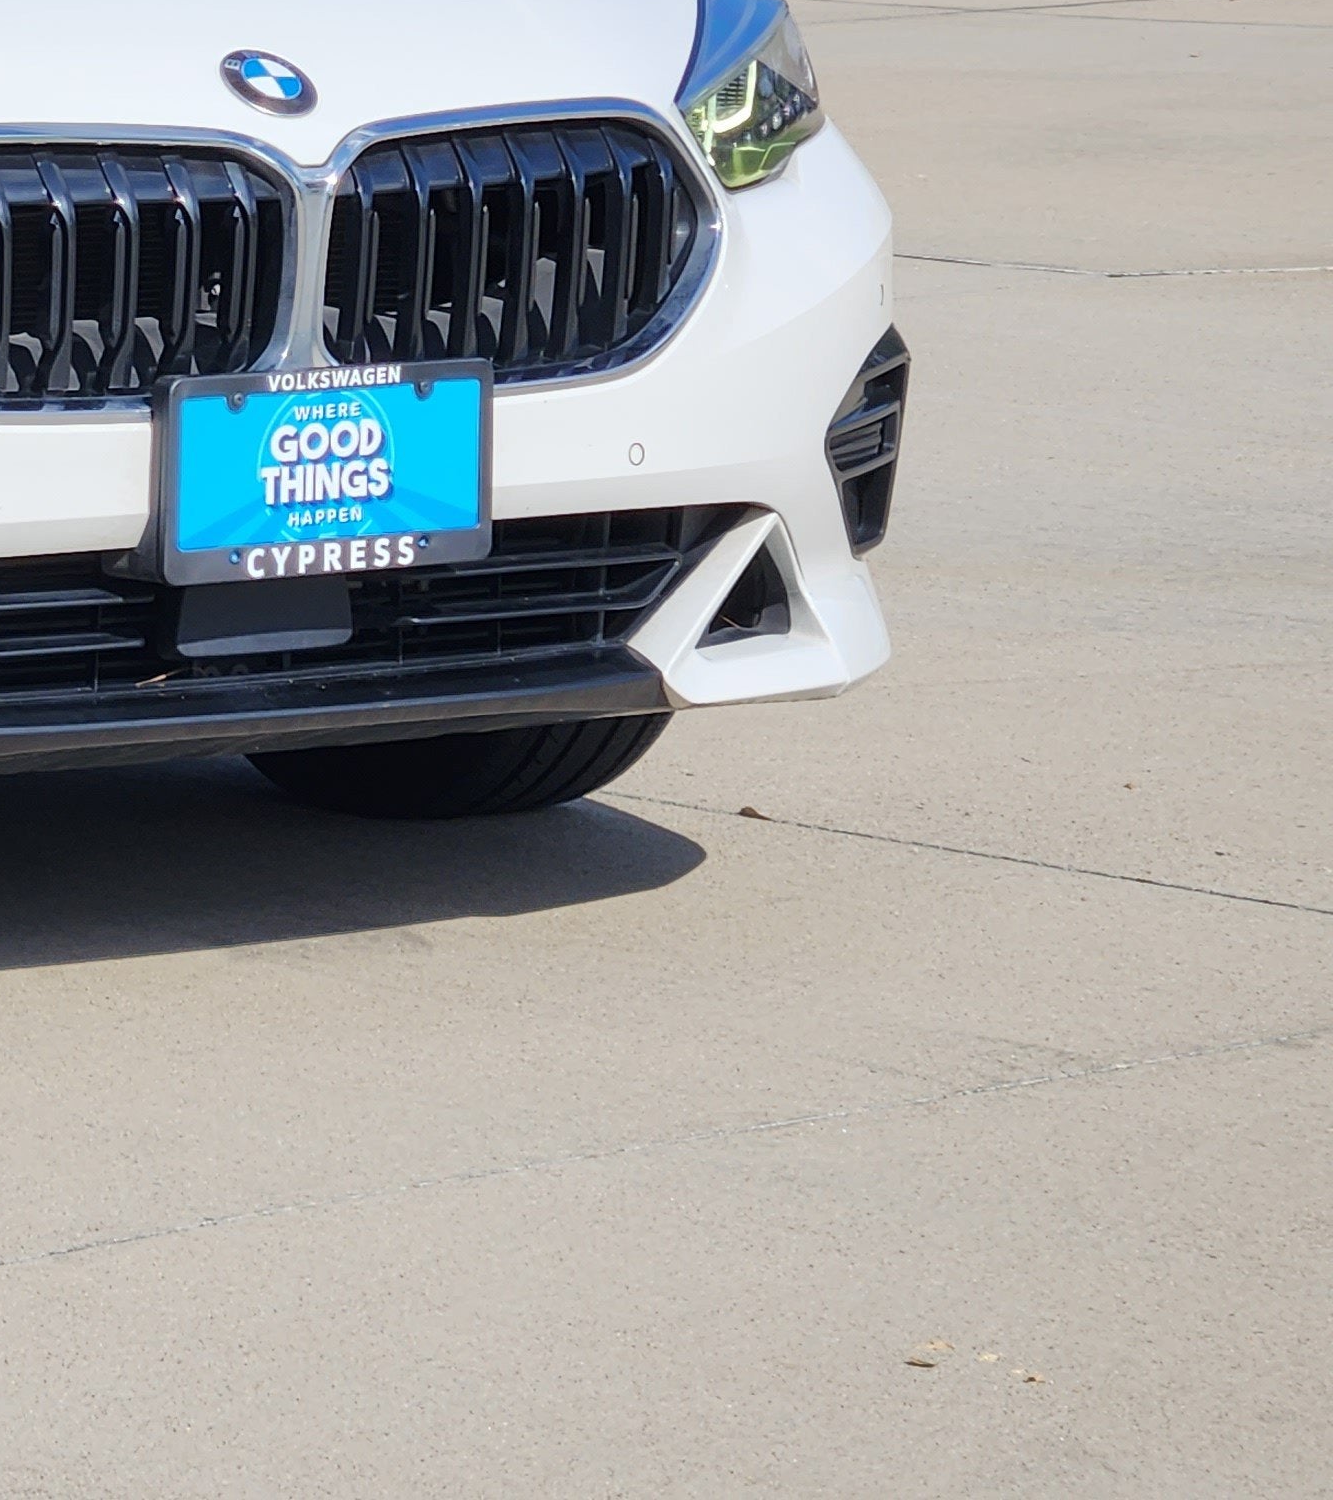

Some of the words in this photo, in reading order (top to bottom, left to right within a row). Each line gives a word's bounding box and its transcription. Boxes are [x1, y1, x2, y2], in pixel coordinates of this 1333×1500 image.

[267, 365, 402, 392] VOLKSWAGEN
[293, 402, 362, 420] WHERE
[269, 418, 384, 463] GOOD
[260, 461, 392, 506] THINGS
[287, 506, 364, 528] HAPPEN
[246, 535, 416, 579] CYPRESS
